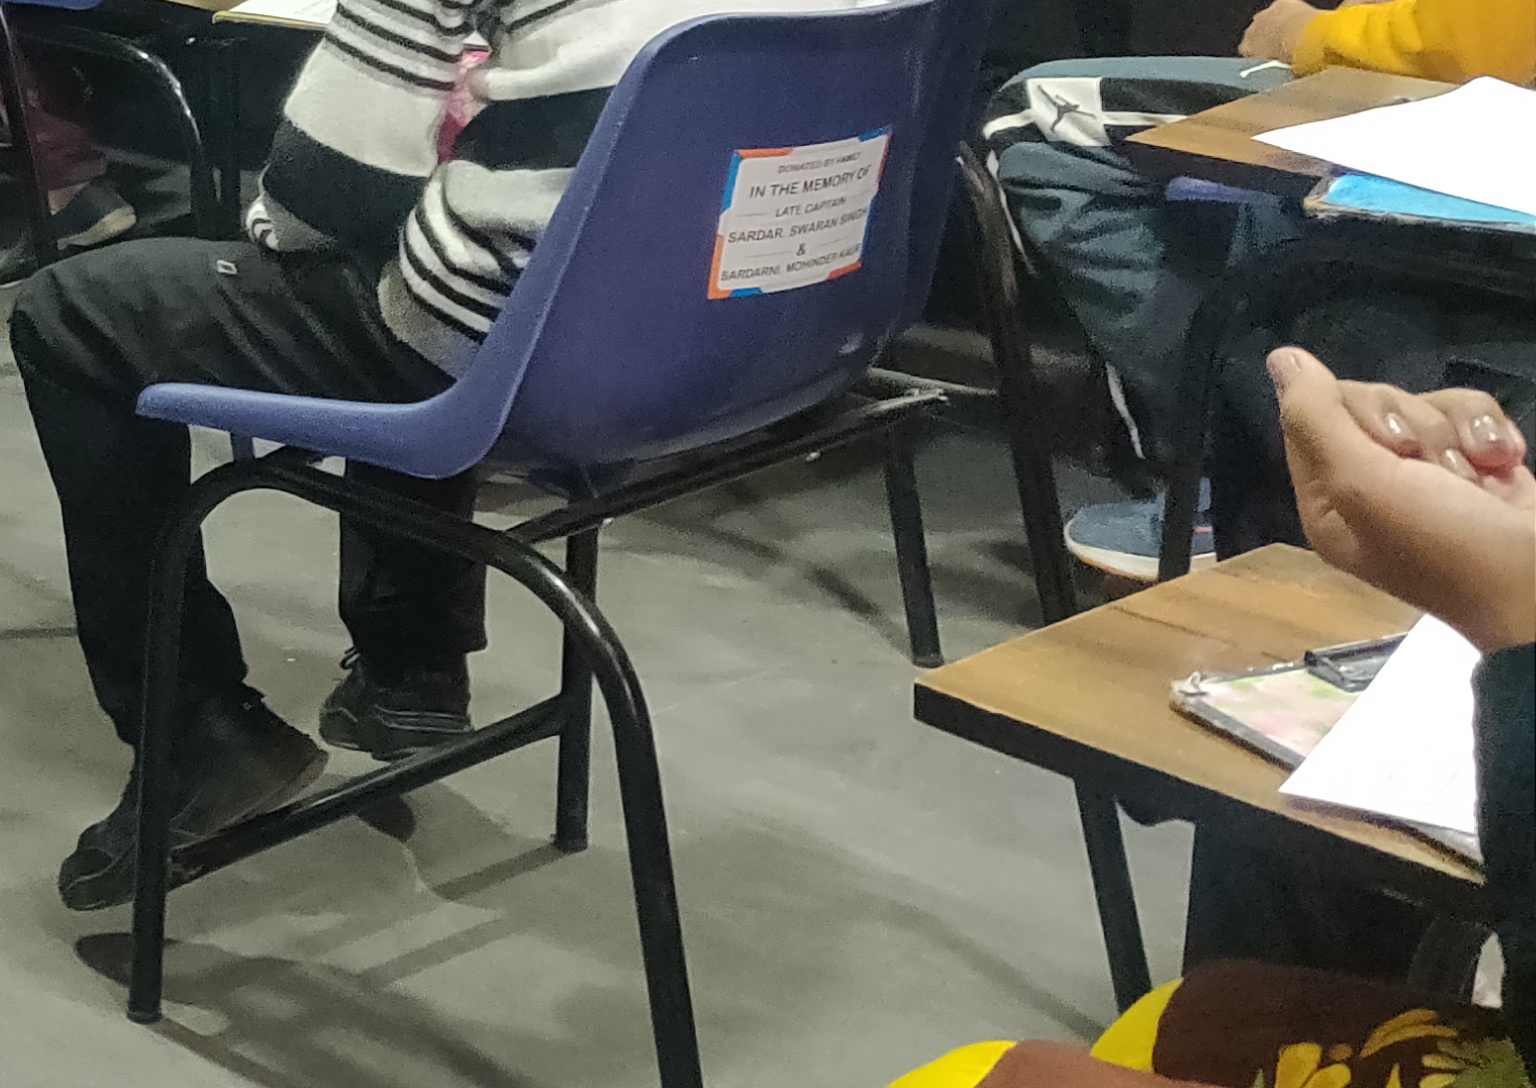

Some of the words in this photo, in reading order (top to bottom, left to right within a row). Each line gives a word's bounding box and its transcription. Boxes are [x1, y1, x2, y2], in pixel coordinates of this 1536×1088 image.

[750, 186, 766, 198] IN
[770, 182, 799, 196] THE
[802, 172, 855, 191] MEMORY
[857, 165, 872, 179] OF
[775, 207, 802, 217] LATE
[805, 196, 846, 213] CAPTAIN
[789, 218, 838, 237] SWARAN
[796, 243, 806, 256] &
[786, 252, 838, 273] MOHINDER
